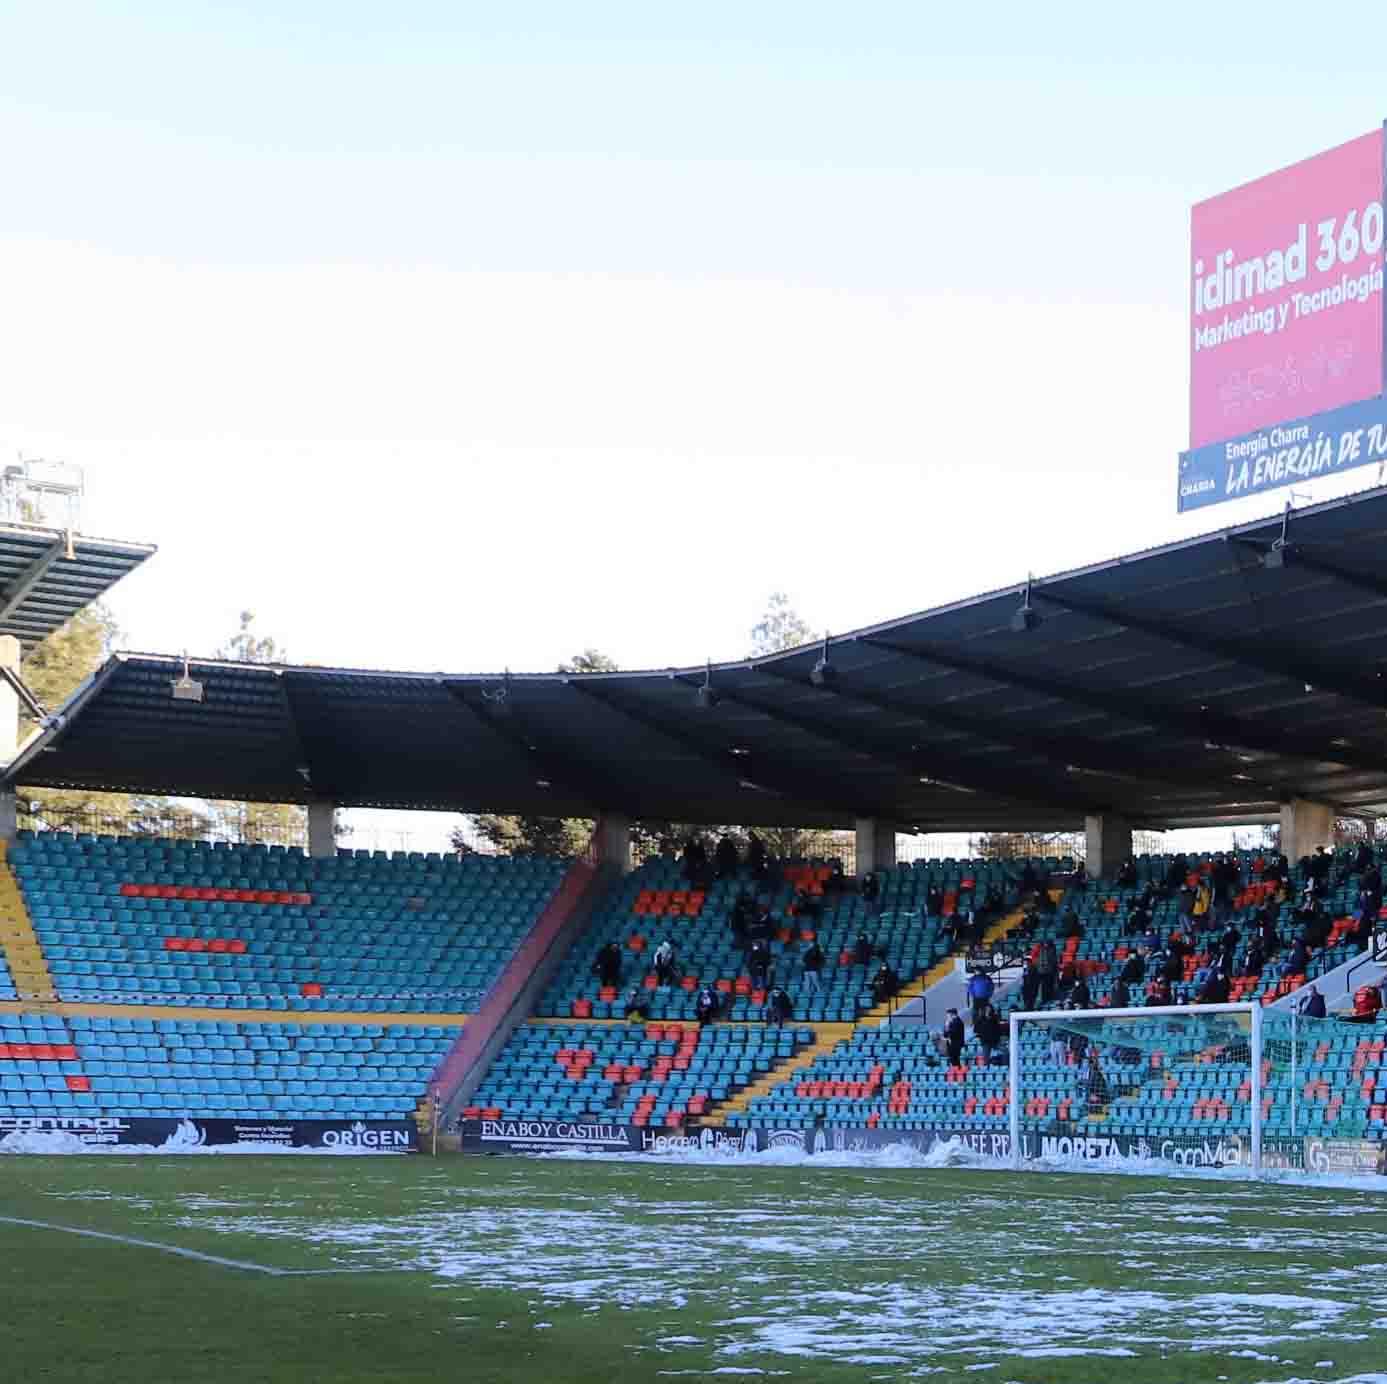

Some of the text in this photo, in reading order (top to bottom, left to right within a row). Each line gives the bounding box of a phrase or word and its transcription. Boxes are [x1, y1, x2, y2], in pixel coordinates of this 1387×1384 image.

[1194, 202, 1384, 316] idimad 360
[1194, 261, 1384, 352] Marketing y Tecnología
[1270, 424, 1310, 448] Charra
[1225, 463, 1249, 495] LA
[1253, 432, 1332, 485] ENERGÍA
[1337, 429, 1361, 465] DE
[481, 1121, 628, 1140] ENABOY CASTILLA
[992, 1134, 1033, 1159] REL
